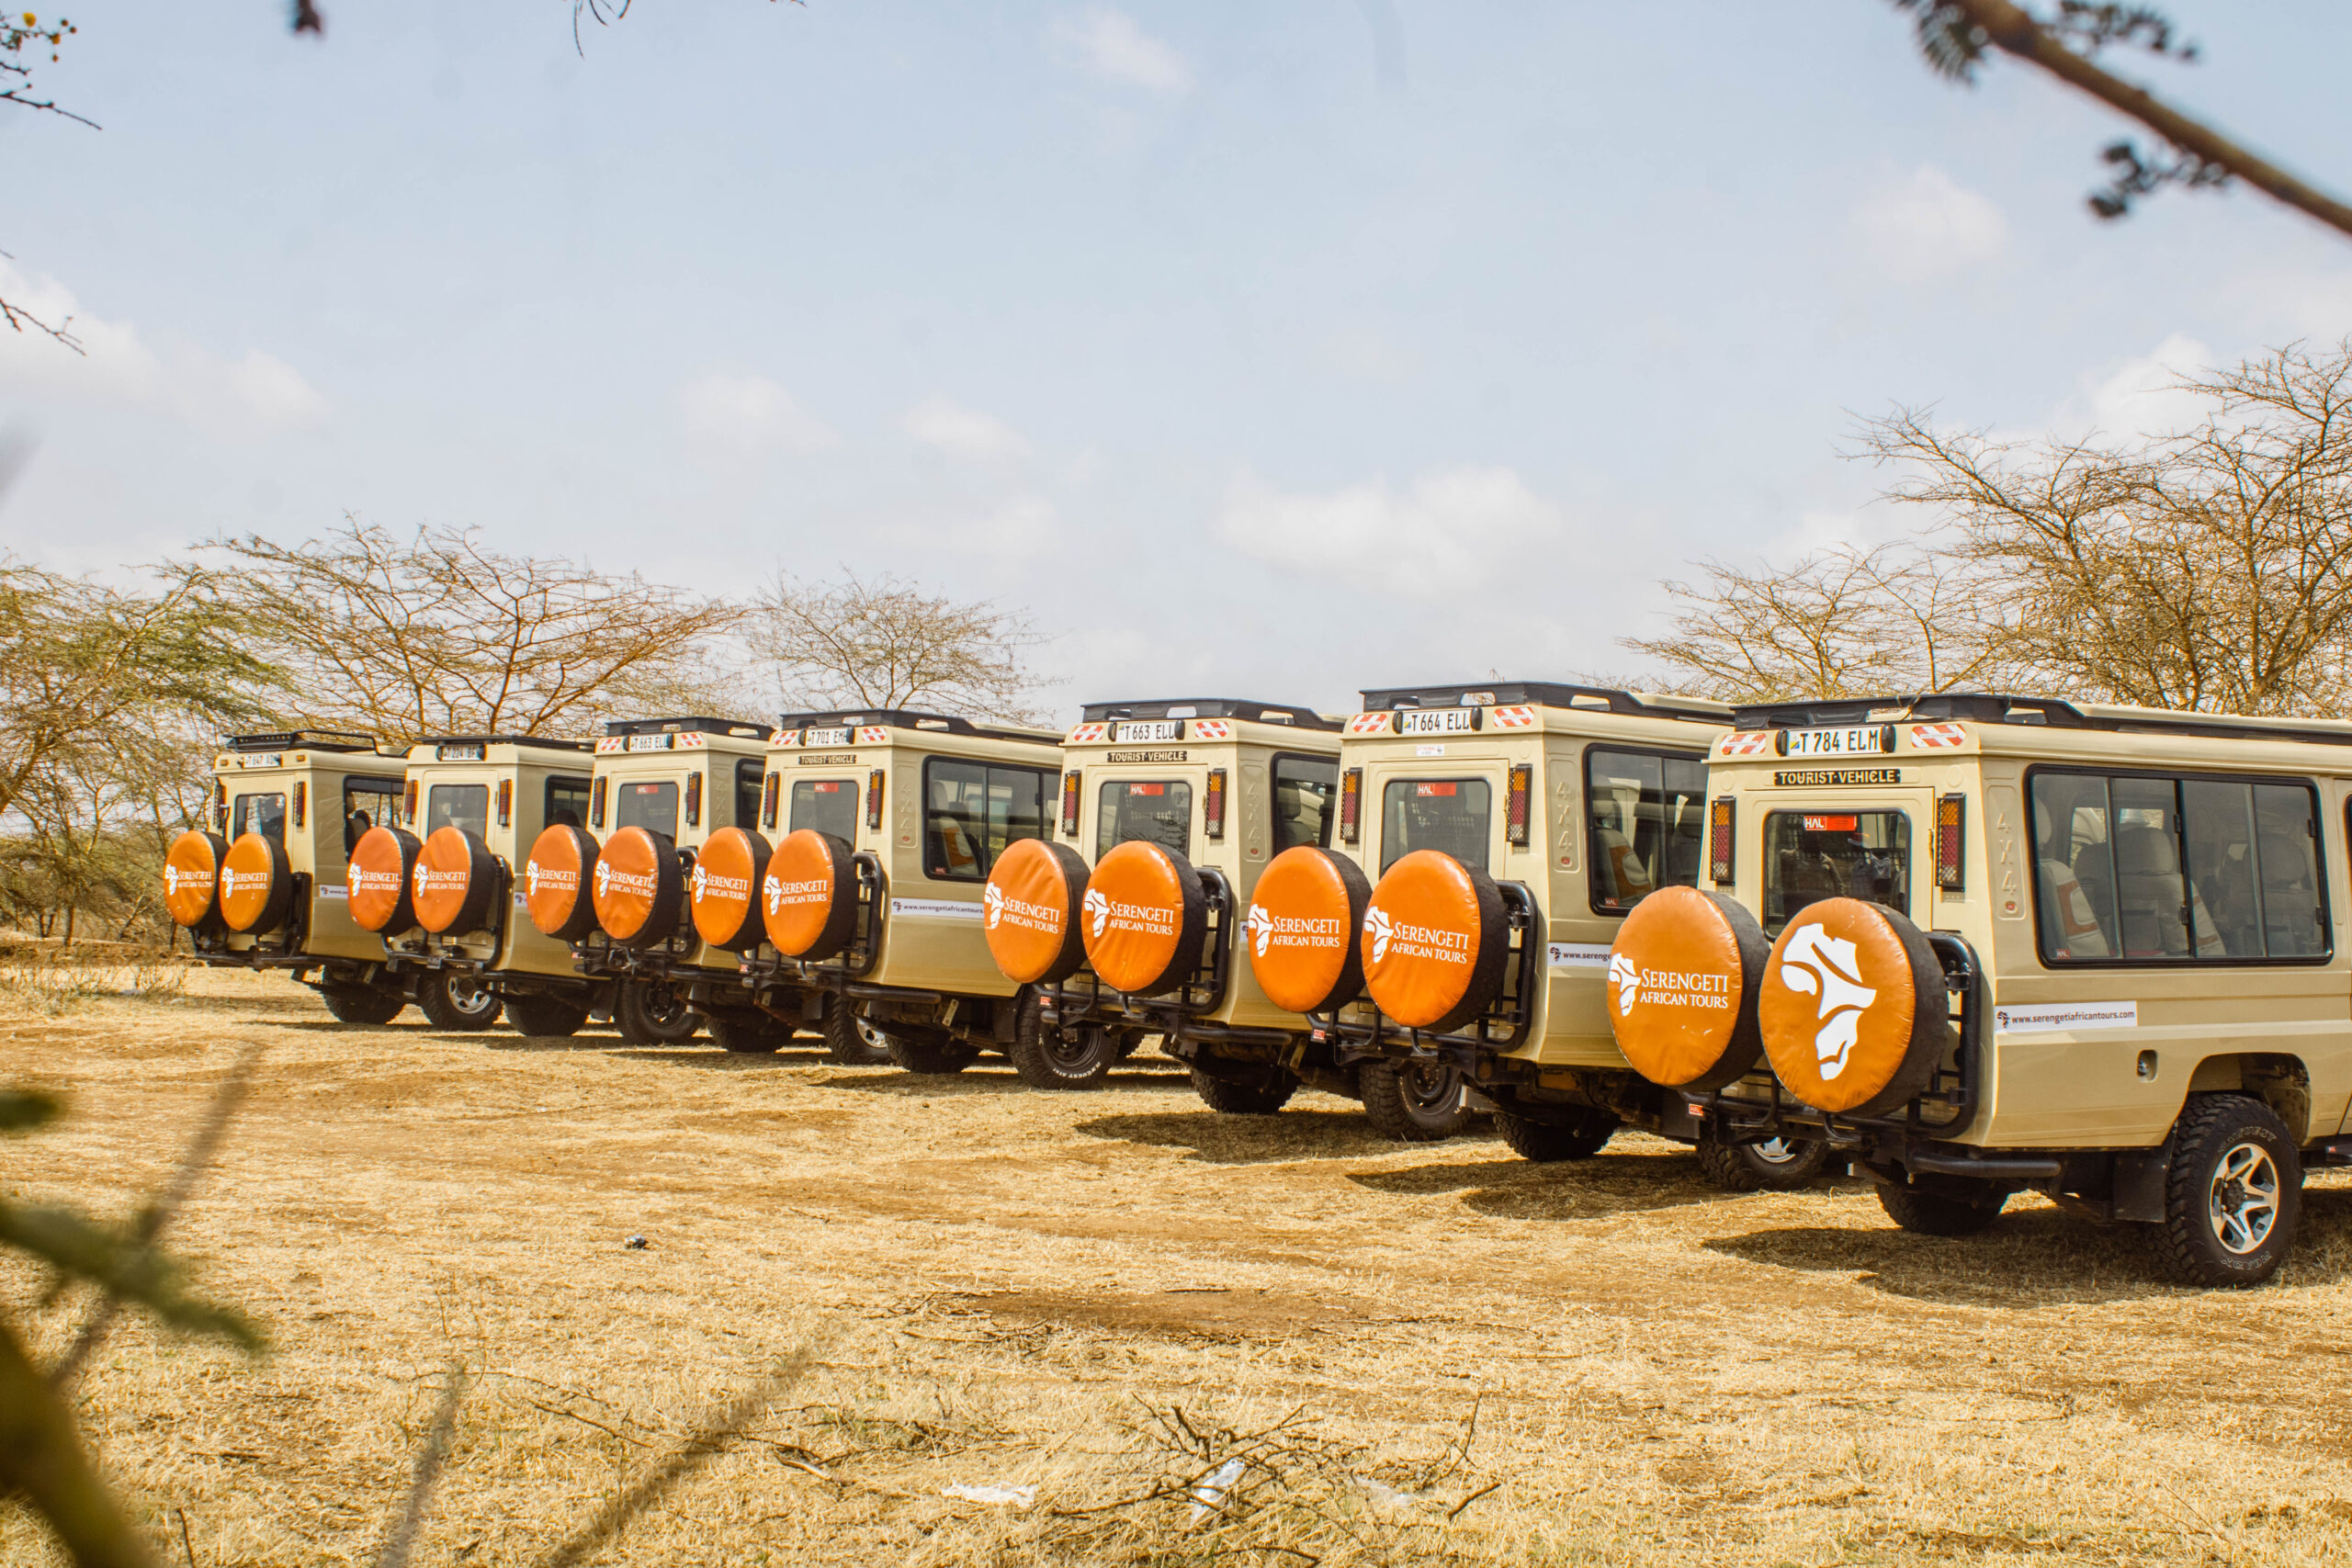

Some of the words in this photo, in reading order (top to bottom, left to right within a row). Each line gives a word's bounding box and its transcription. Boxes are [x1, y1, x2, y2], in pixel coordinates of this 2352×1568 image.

[1411, 715, 1418, 732] T
[1420, 714, 1440, 731] 664
[1447, 713, 1469, 730] ELL
[1125, 726, 1130, 740] T
[1133, 725, 1150, 739] 663
[1156, 724, 1175, 739] ELL
[1800, 733, 1809, 752] T
[1814, 731, 1840, 752] 784
[1848, 729, 1878, 751] ELM
[1110, 752, 1146, 762] TOURIST
[1148, 751, 1184, 761] VEHICLE
[1780, 772, 1835, 785] TOURIST
[1838, 770, 1895, 784] VEHICLE
[1418, 784, 1433, 795] HAL
[1804, 818, 1825, 829] HAL
[361, 870, 399, 883] SERENGETI
[428, 870, 467, 882] SERENGETI
[538, 868, 577, 882] SERENGETI
[707, 874, 748, 891] SERENGETI
[705, 888, 729, 897] AFRICAN
[729, 891, 747, 901] TOURS
[781, 880, 828, 895] SERENGETI
[781, 896, 806, 905] AFRICAN
[807, 893, 828, 903] TOURS
[1003, 896, 1060, 922] SERENGETI
[1110, 901, 1174, 923] SERENGETI
[1002, 913, 1034, 929] AFRICAN
[1034, 920, 1058, 934] TOURS
[1109, 919, 1144, 932] AFRICAN
[1145, 922, 1173, 936] TOURS
[1273, 916, 1340, 934] SERENGETI
[1272, 935, 1309, 947] AFRICAN
[1310, 935, 1340, 948] TOURS
[1394, 921, 1470, 950] SERENGETI
[1391, 944, 1433, 958] AFRICAN
[1434, 948, 1467, 964] TOURS
[1641, 968, 1729, 993] SERENGETI
[1640, 991, 1688, 1006] AFRICAN
[1690, 994, 1728, 1009] TOURS
[2011, 1010, 2134, 1025] www.serengetiafricantours.com
